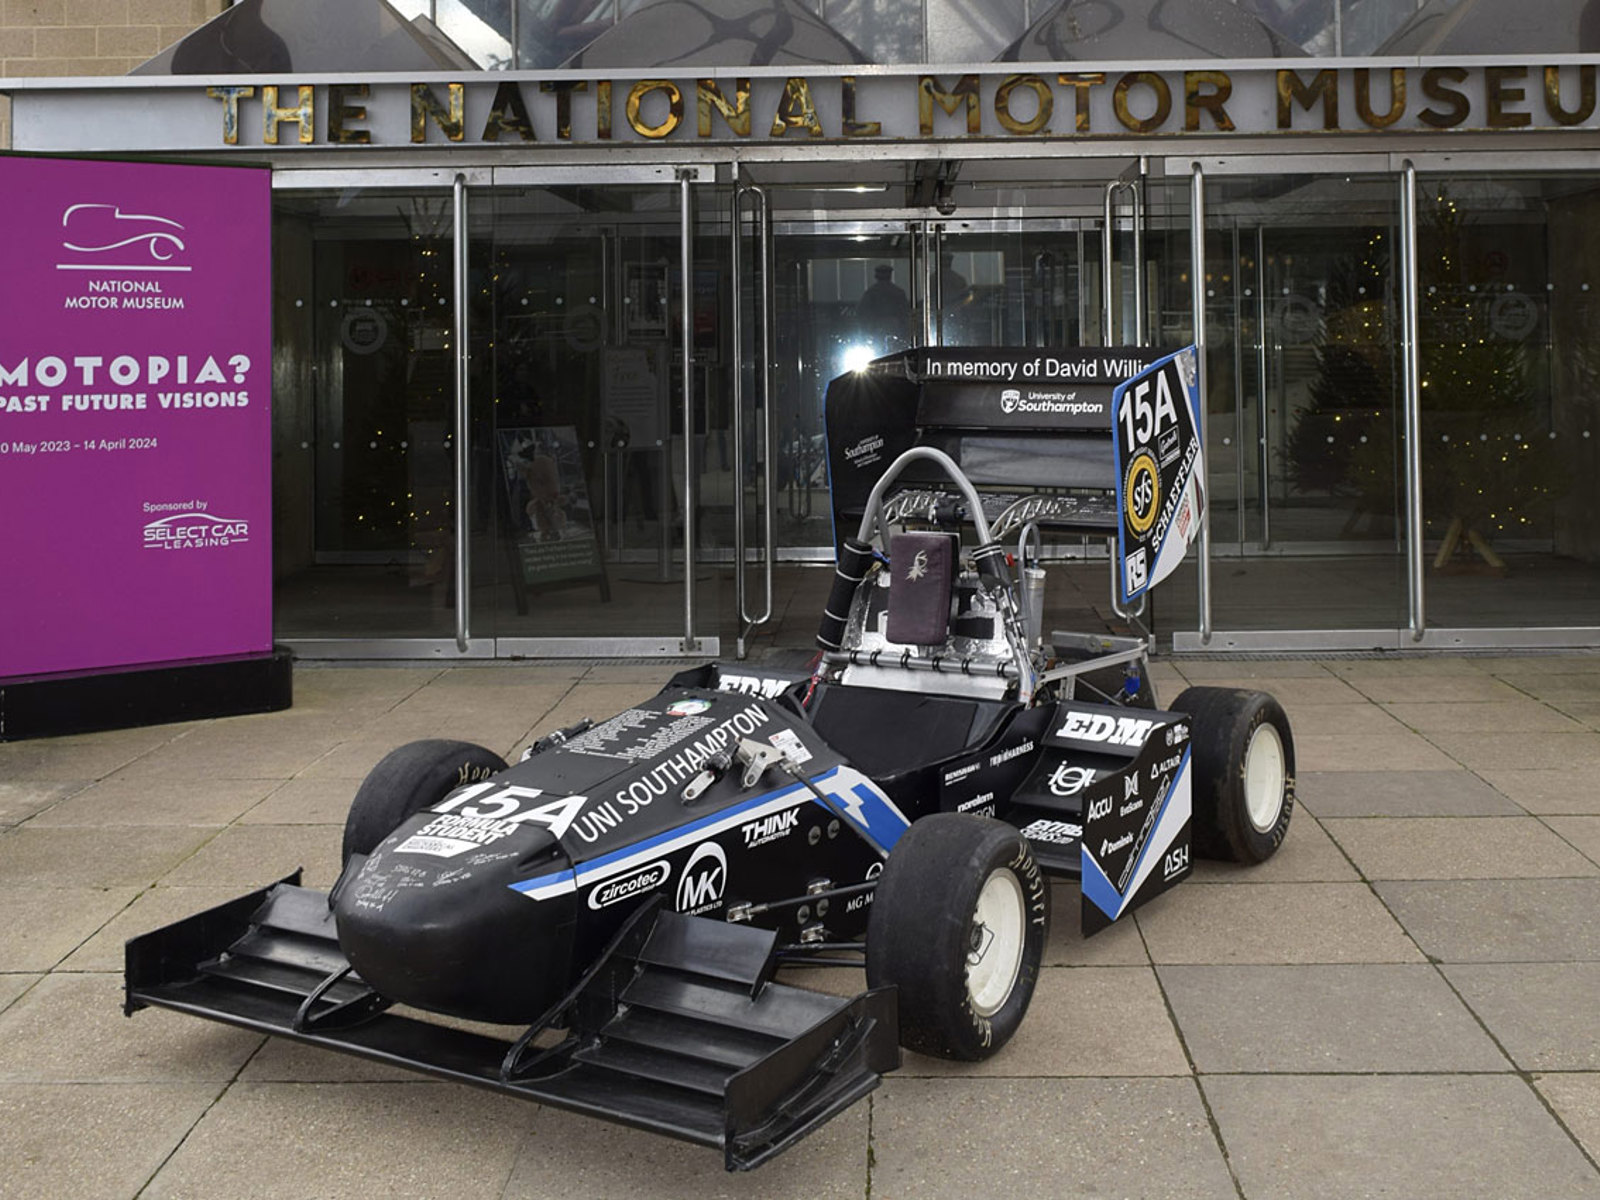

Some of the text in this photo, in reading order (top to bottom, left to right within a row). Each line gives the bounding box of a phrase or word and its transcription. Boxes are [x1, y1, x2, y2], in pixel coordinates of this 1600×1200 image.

[206, 84, 371, 145] THE
[410, 76, 882, 144] NATIONAL
[918, 70, 1236, 136] MOTOR
[88, 280, 163, 293] NATIONAL
[64, 296, 185, 310] MOTOR MUSEUM
[0, 354, 251, 387] MOTOPIA?
[926, 357, 942, 376] In
[947, 359, 1018, 381] memory
[1022, 357, 1042, 378] of
[1045, 358, 1098, 378] David
[61, 393, 147, 411] FUTURE
[158, 391, 249, 409] VISIONS
[1018, 399, 1104, 415] Southampton
[1027, 391, 1077, 402] University of
[1118, 369, 1178, 453] 15A
[12, 441, 37, 455] May
[40, 440, 71, 452] 2023
[83, 440, 97, 451] 14
[98, 438, 126, 452] April
[129, 437, 158, 450] 2024
[1151, 435, 1200, 553] SCHAEFFLER
[143, 500, 208, 514] Sponsored by
[143, 523, 248, 542] SELECT CAR
[164, 536, 230, 550] LEASING
[571, 801, 624, 843] UNI
[615, 703, 770, 815] SOUTHAMPTON
[430, 782, 589, 840] 15A
[417, 824, 506, 845] STUDENT
[431, 814, 521, 836] FORMULA
[741, 808, 801, 843] THINK
[600, 870, 660, 903] zircotec
[681, 865, 722, 911] MK
